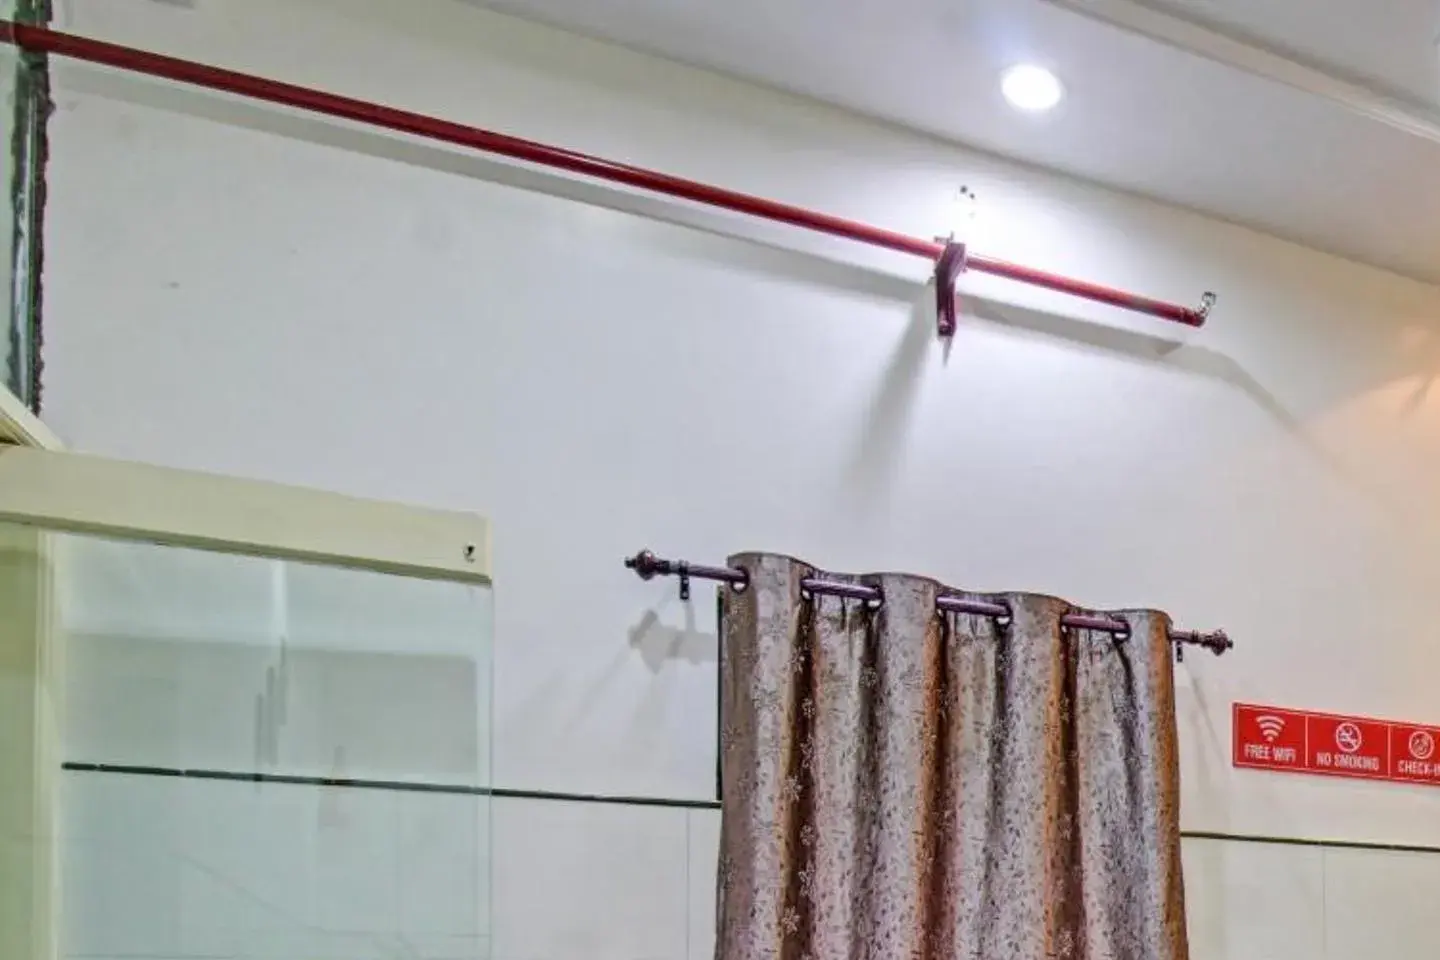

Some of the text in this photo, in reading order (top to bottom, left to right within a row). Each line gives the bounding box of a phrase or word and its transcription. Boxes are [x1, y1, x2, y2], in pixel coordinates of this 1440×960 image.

[1244, 744, 1270, 760] FREE
[1317, 752, 1380, 771] NO SMOKING
